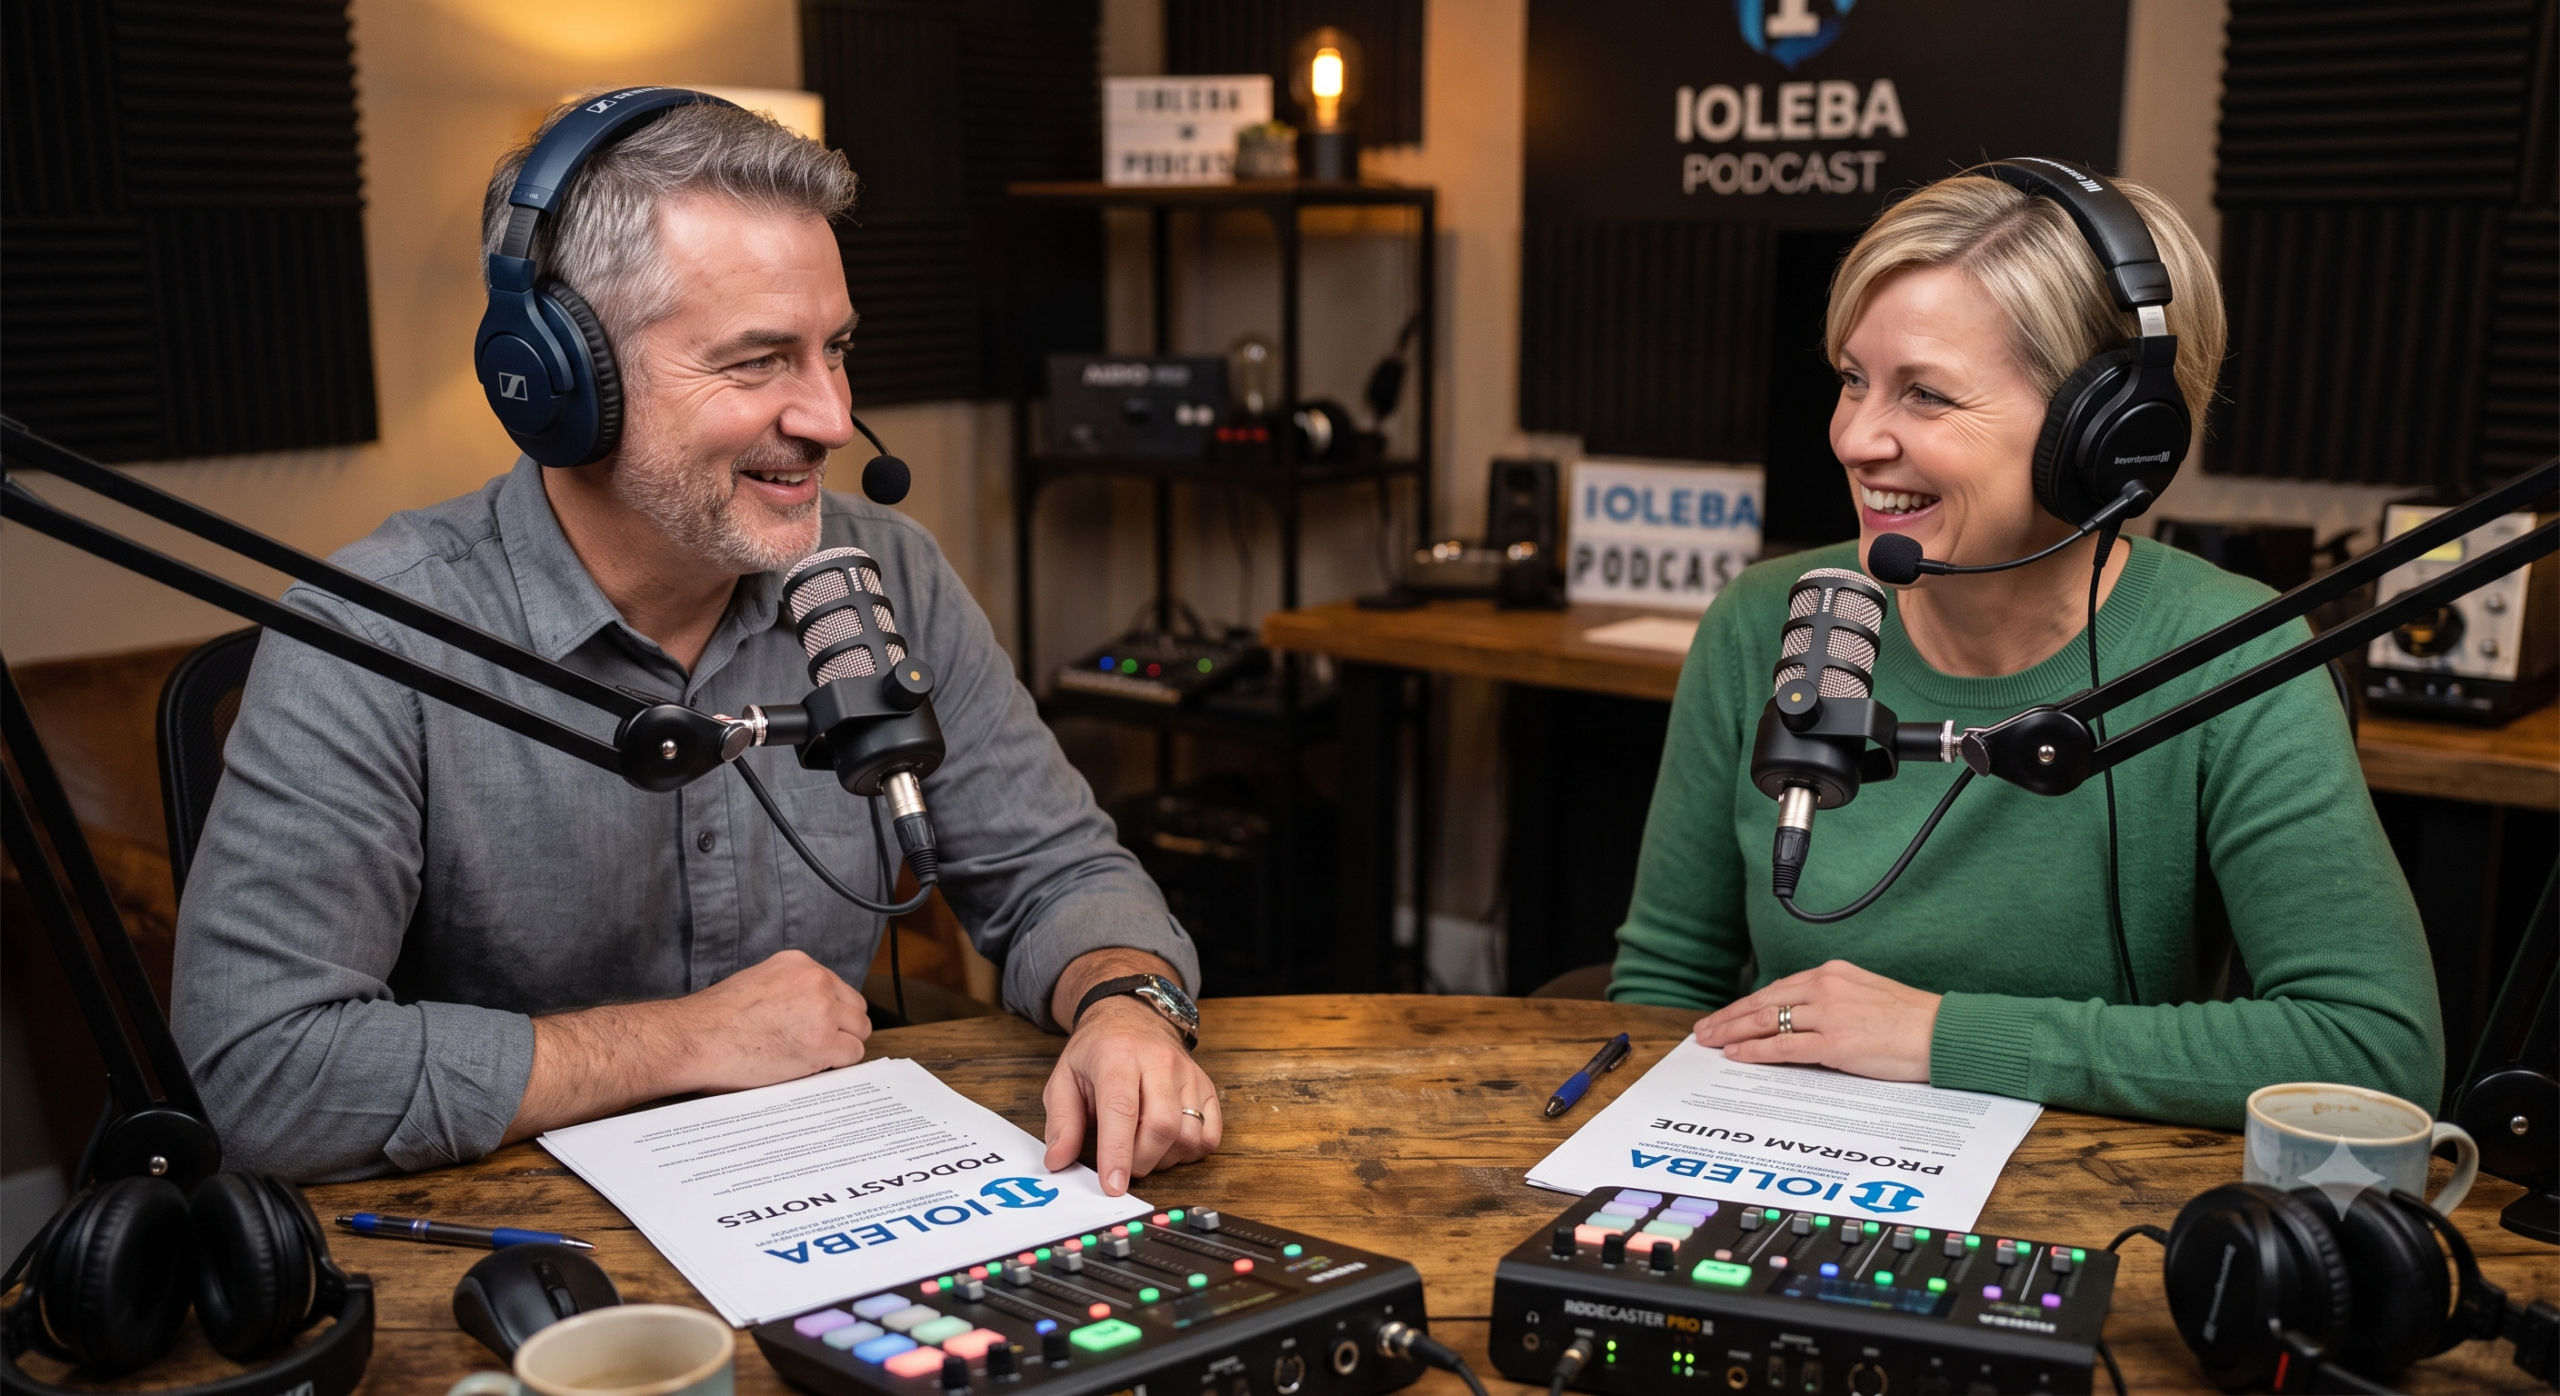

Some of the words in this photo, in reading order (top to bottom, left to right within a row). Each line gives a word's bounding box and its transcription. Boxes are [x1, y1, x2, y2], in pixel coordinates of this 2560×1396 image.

[1675, 78, 1908, 143] IOLEBA
[1122, 152, 1236, 175] PODCAS
[1682, 150, 1886, 195] PODCAST
[1585, 483, 1762, 530] IOLEBA
[1650, 1117, 1755, 1144] GUIDE
[846, 1152, 1006, 1200] PODCAST
[1630, 1149, 1844, 1201] IOLEBA
[1763, 1137, 1945, 1176] PROGRAM
[716, 1192, 838, 1228] NOTES
[763, 1198, 993, 1265] IOLEBA
[1666, 1314, 1701, 1333] PRO
